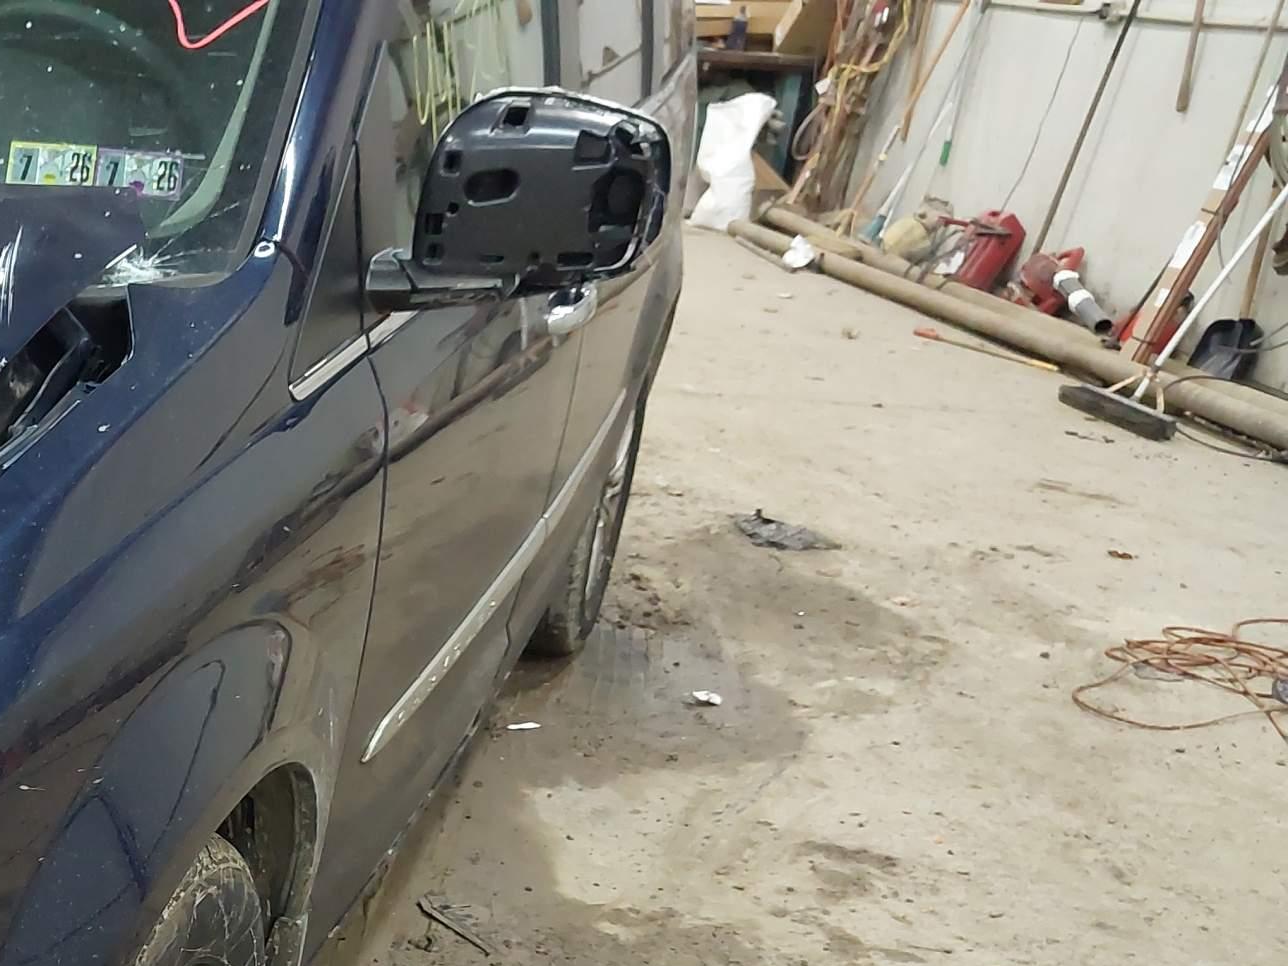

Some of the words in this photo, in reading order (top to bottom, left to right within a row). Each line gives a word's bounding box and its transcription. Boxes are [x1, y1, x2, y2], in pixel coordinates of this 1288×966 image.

[19, 154, 33, 182] 7
[69, 152, 92, 183] 26
[106, 160, 119, 186] 7
[156, 160, 179, 192] 26
